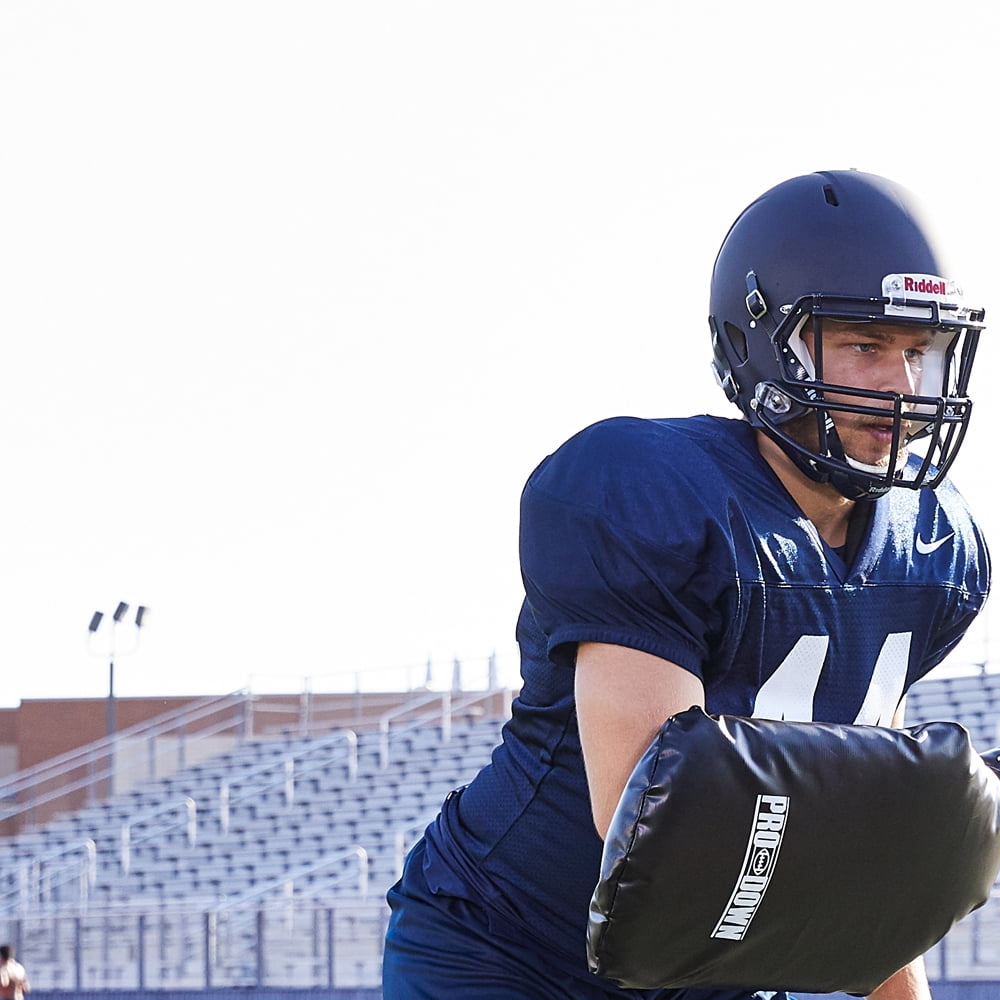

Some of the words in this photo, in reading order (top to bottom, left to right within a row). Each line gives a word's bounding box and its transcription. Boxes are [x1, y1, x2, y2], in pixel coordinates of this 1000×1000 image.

[904, 276, 946, 295] Riddell
[754, 795, 787, 848] PRO
[715, 875, 768, 940] DOWN
